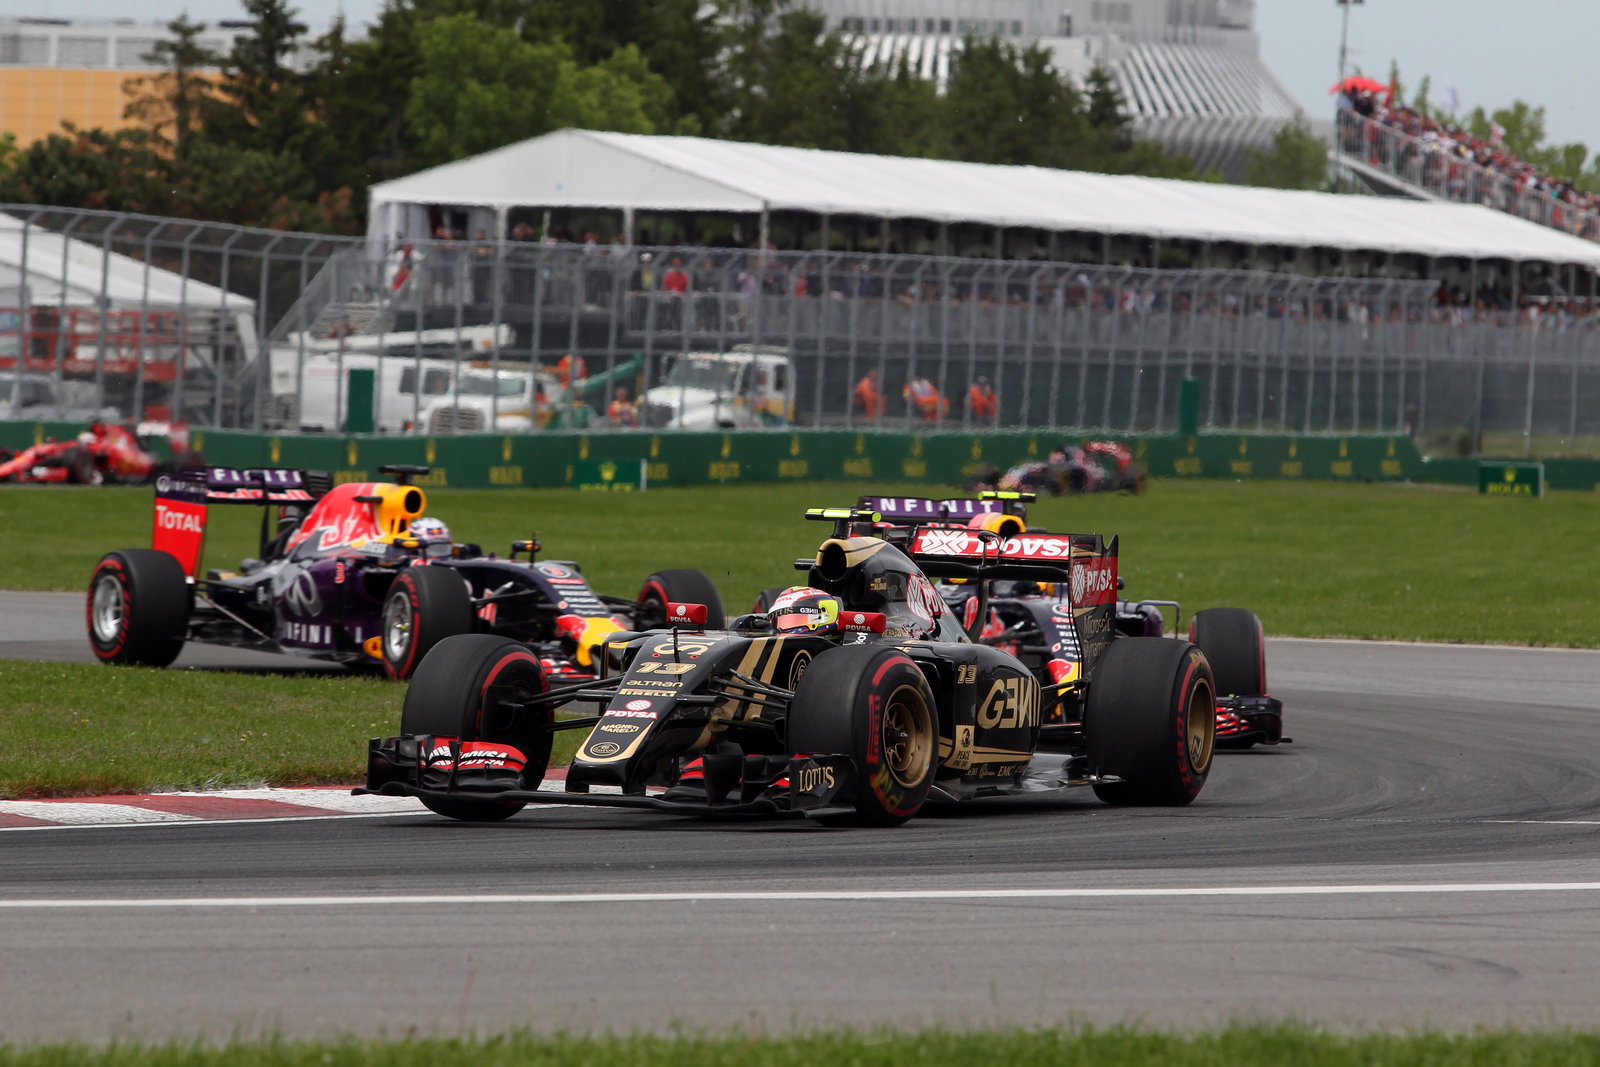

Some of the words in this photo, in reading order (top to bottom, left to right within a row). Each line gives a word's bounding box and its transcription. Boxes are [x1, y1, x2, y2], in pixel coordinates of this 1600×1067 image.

[335, 562, 345, 584] 3
[669, 615, 692, 623] PDVSA
[845, 624, 872, 632] PDVSA
[636, 661, 697, 675] 13
[957, 664, 978, 684] 13
[618, 688, 678, 698] PIRELLI
[603, 710, 658, 720] PDVSA
[798, 765, 836, 793] LOTUS
